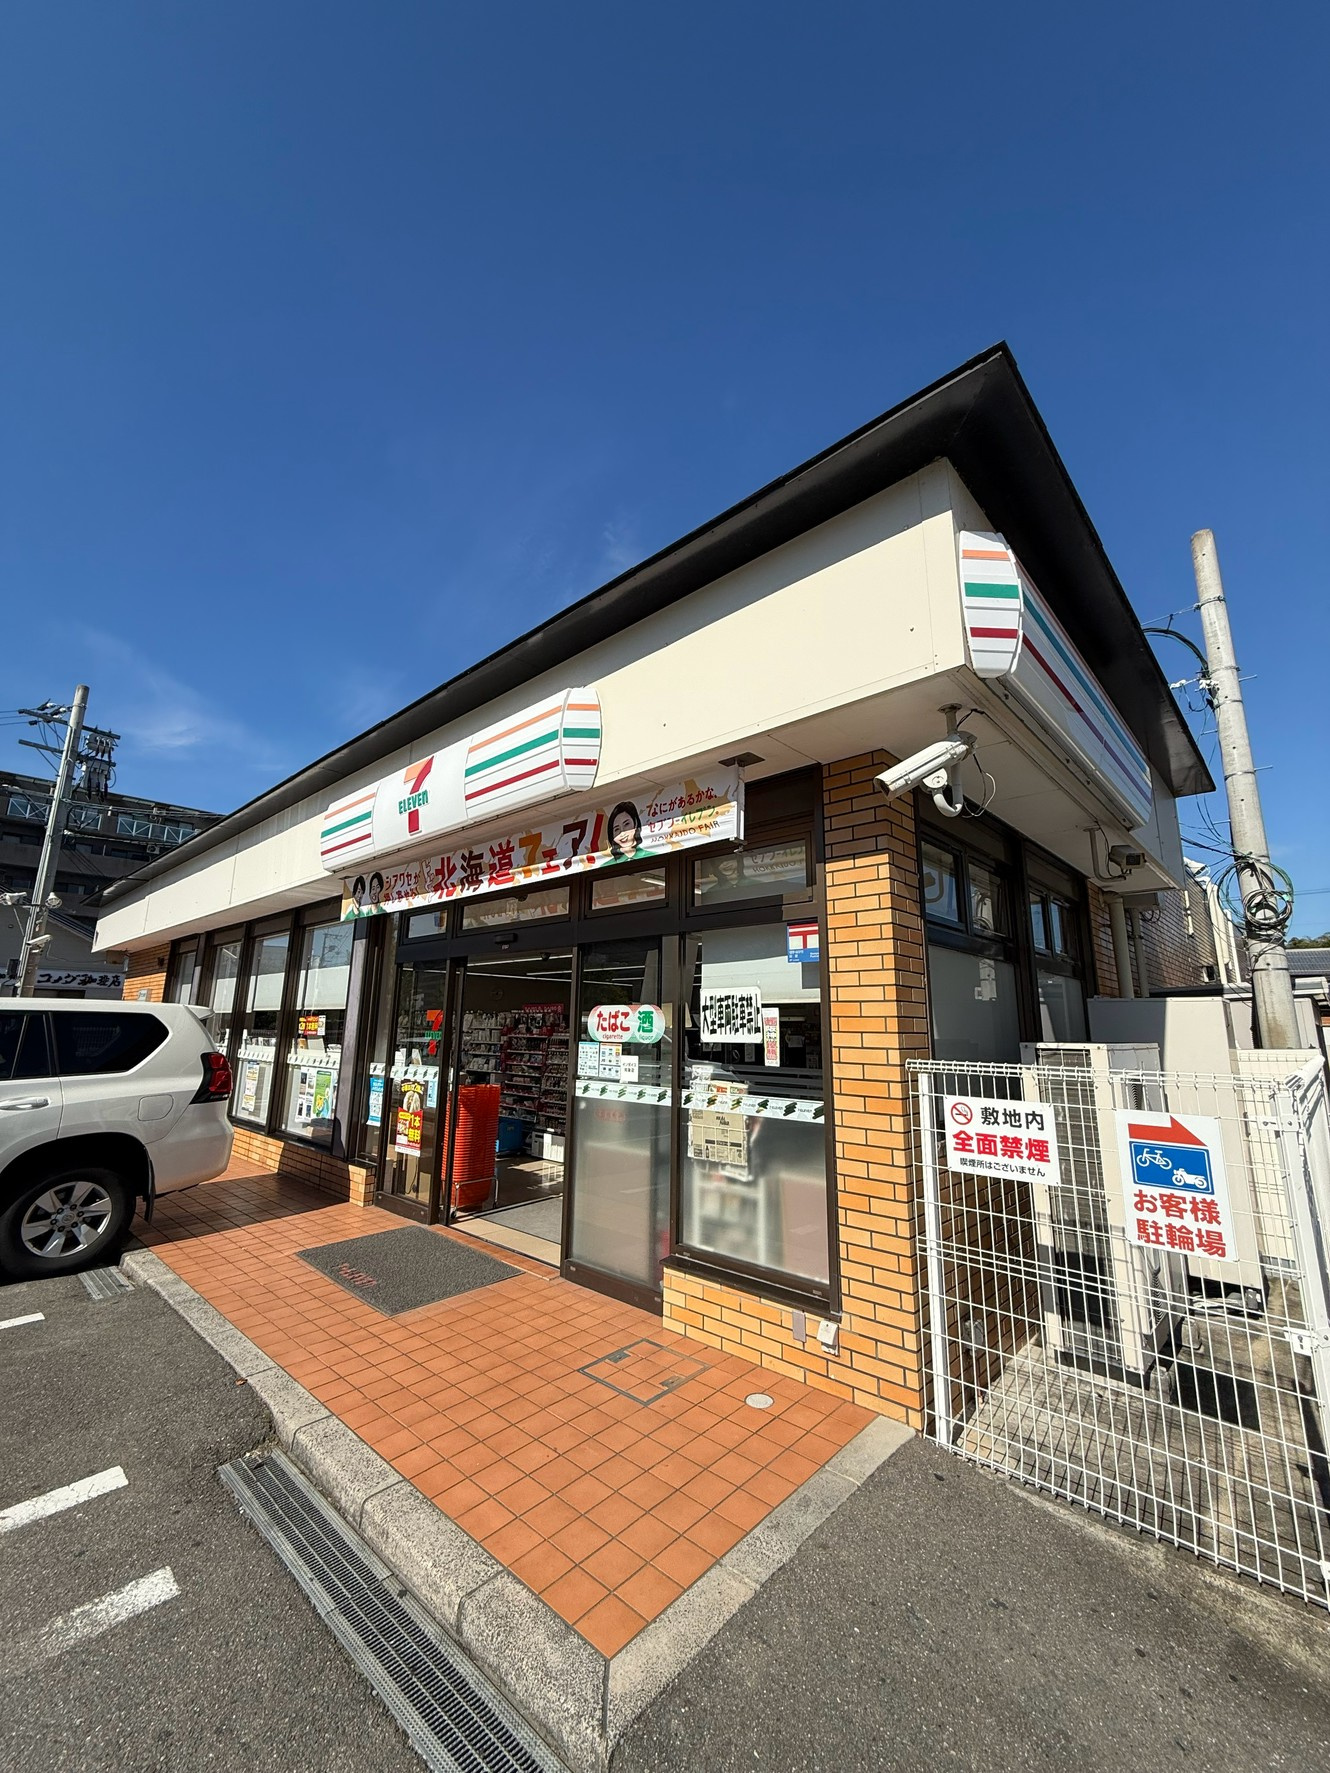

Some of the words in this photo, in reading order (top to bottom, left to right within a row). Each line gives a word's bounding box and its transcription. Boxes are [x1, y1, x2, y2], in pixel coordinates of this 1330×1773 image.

[651, 827, 696, 844] HOKKAIDO
[698, 820, 721, 833] FAIR
[596, 1010, 631, 1033] たばこ
[637, 1010, 654, 1033] 酒
[981, 1106, 1045, 1131] 敷地内
[952, 1130, 1051, 1163] 全面禁煙
[959, 1157, 1046, 1178] 喫煙所はございません
[1134, 1189, 1222, 1226] お客様
[1137, 1218, 1226, 1259] 駐輪場
